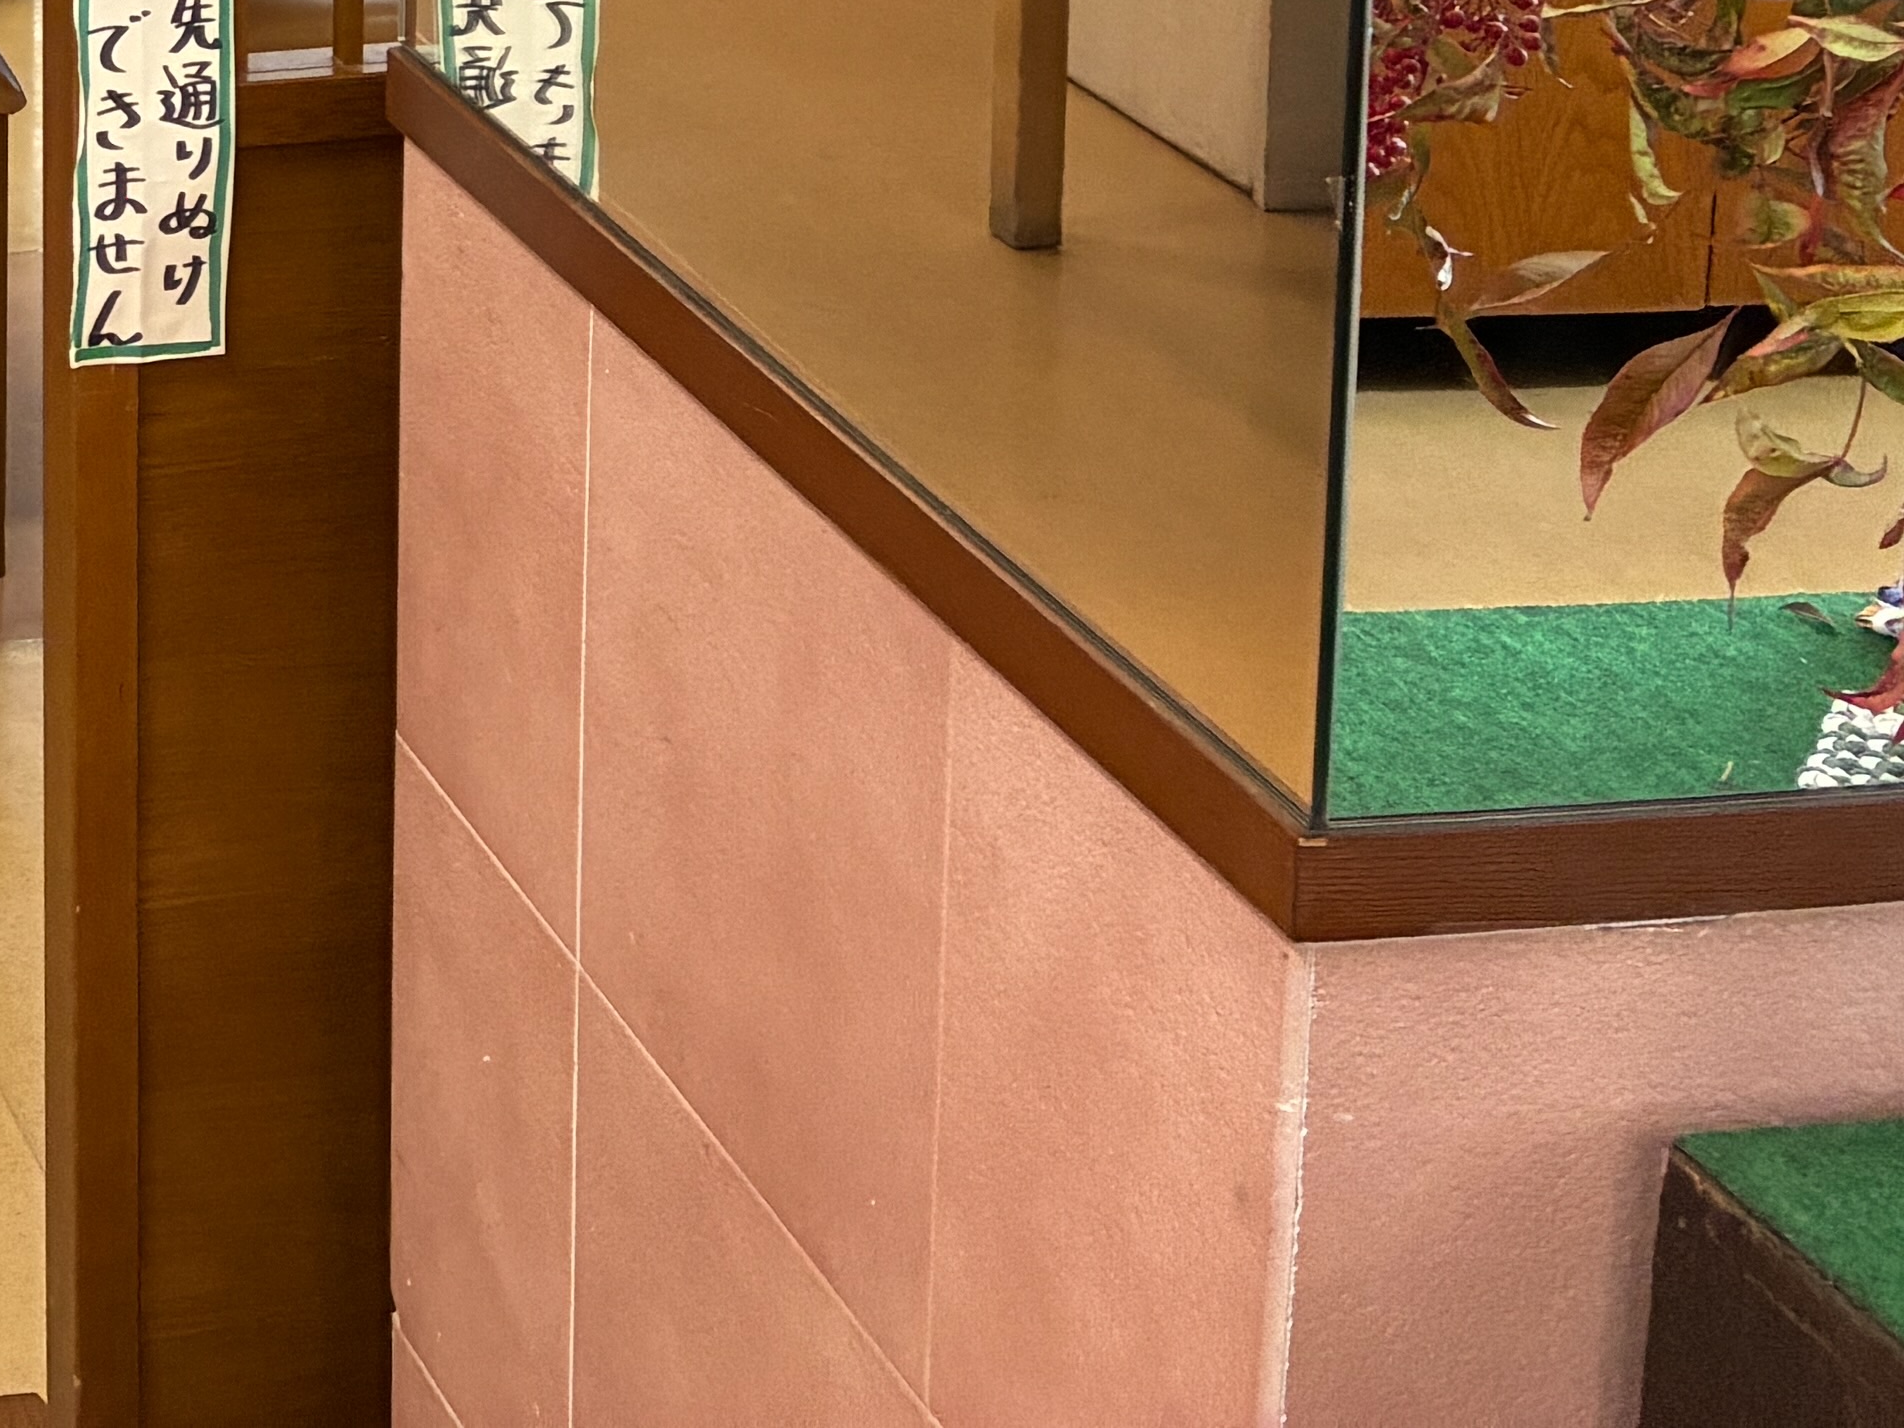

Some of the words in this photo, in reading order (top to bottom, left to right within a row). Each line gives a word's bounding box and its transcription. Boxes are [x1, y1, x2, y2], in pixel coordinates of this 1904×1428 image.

[87, 9, 150, 347] できません
